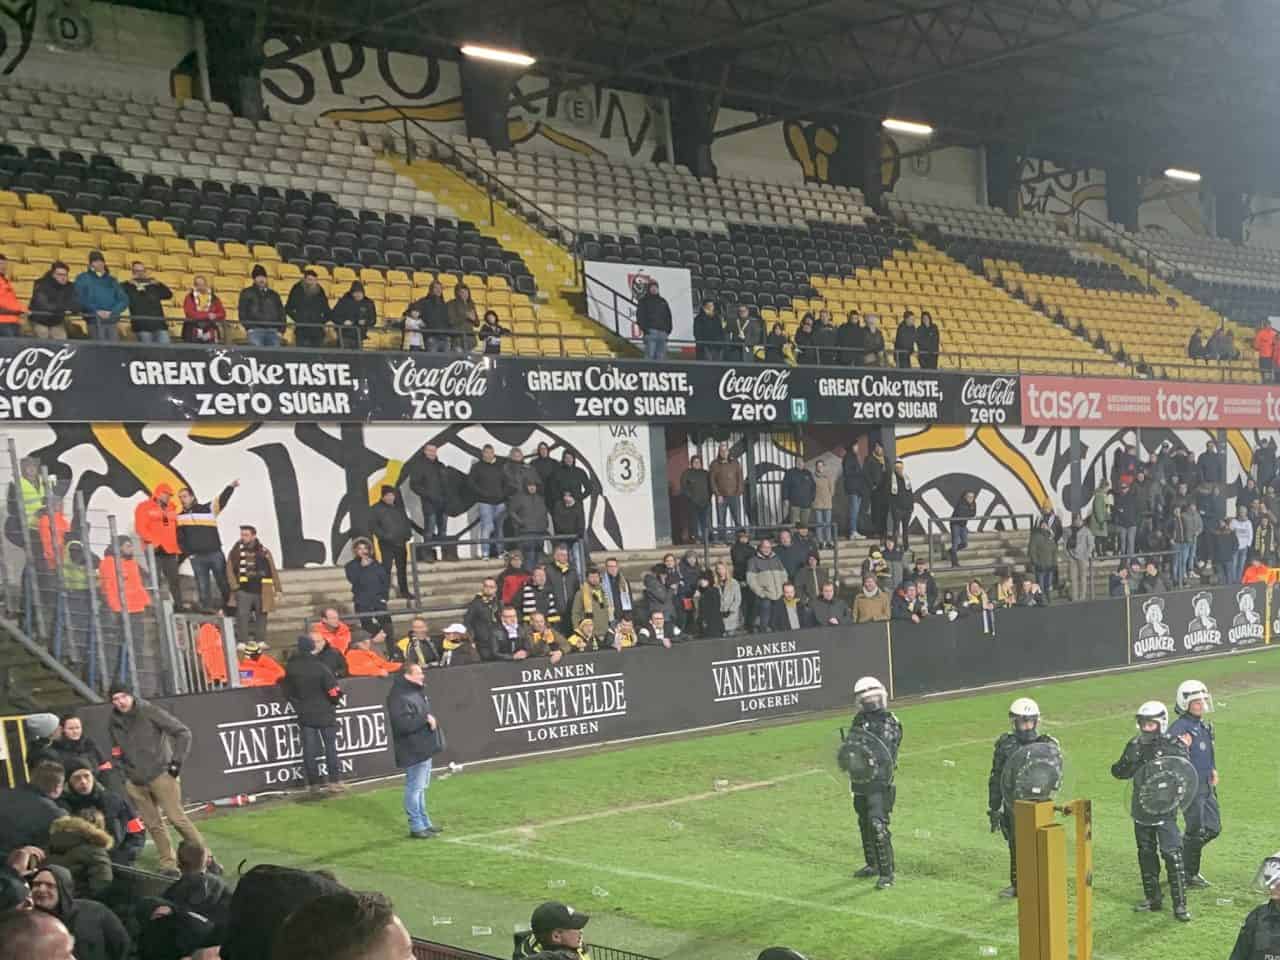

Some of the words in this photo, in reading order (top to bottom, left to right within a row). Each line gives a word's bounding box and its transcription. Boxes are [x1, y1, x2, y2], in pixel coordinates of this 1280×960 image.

[129, 360, 206, 386] GREAT
[209, 355, 285, 386] Coke
[288, 362, 360, 391] TASTE,
[527, 370, 582, 392] GREAT
[584, 366, 639, 392] Coke
[641, 371, 694, 396] TASTE,
[818, 378, 861, 397] GREAT
[861, 375, 902, 398] Coke
[903, 380, 943, 400] TASTE,
[196, 392, 272, 416] zero
[279, 391, 351, 415] SUGAR
[411, 399, 473, 420] zero
[575, 397, 630, 417] zero
[634, 396, 687, 416] SUGAR
[731, 402, 777, 421] zero
[853, 401, 895, 419] zero
[898, 402, 938, 418] SUGAR
[970, 406, 1006, 423] zero
[609, 425, 638, 438] VAK
[619, 459, 633, 481] 3
[1184, 630, 1223, 650] QUAKER
[1228, 624, 1264, 643] QUAKER
[736, 640, 797, 657] DRANKEN
[1134, 636, 1176, 657] QUAKER
[521, 663, 595, 682] DRANKEN
[712, 665, 744, 696] VAN
[747, 656, 822, 692] EETVELDE
[492, 691, 531, 726] VAN
[534, 679, 627, 721] EETVELDE
[740, 693, 799, 712] LOKEREN
[527, 721, 599, 741] LOKEREN
[219, 726, 271, 767] VAN
[265, 759, 353, 784] LOKRN
